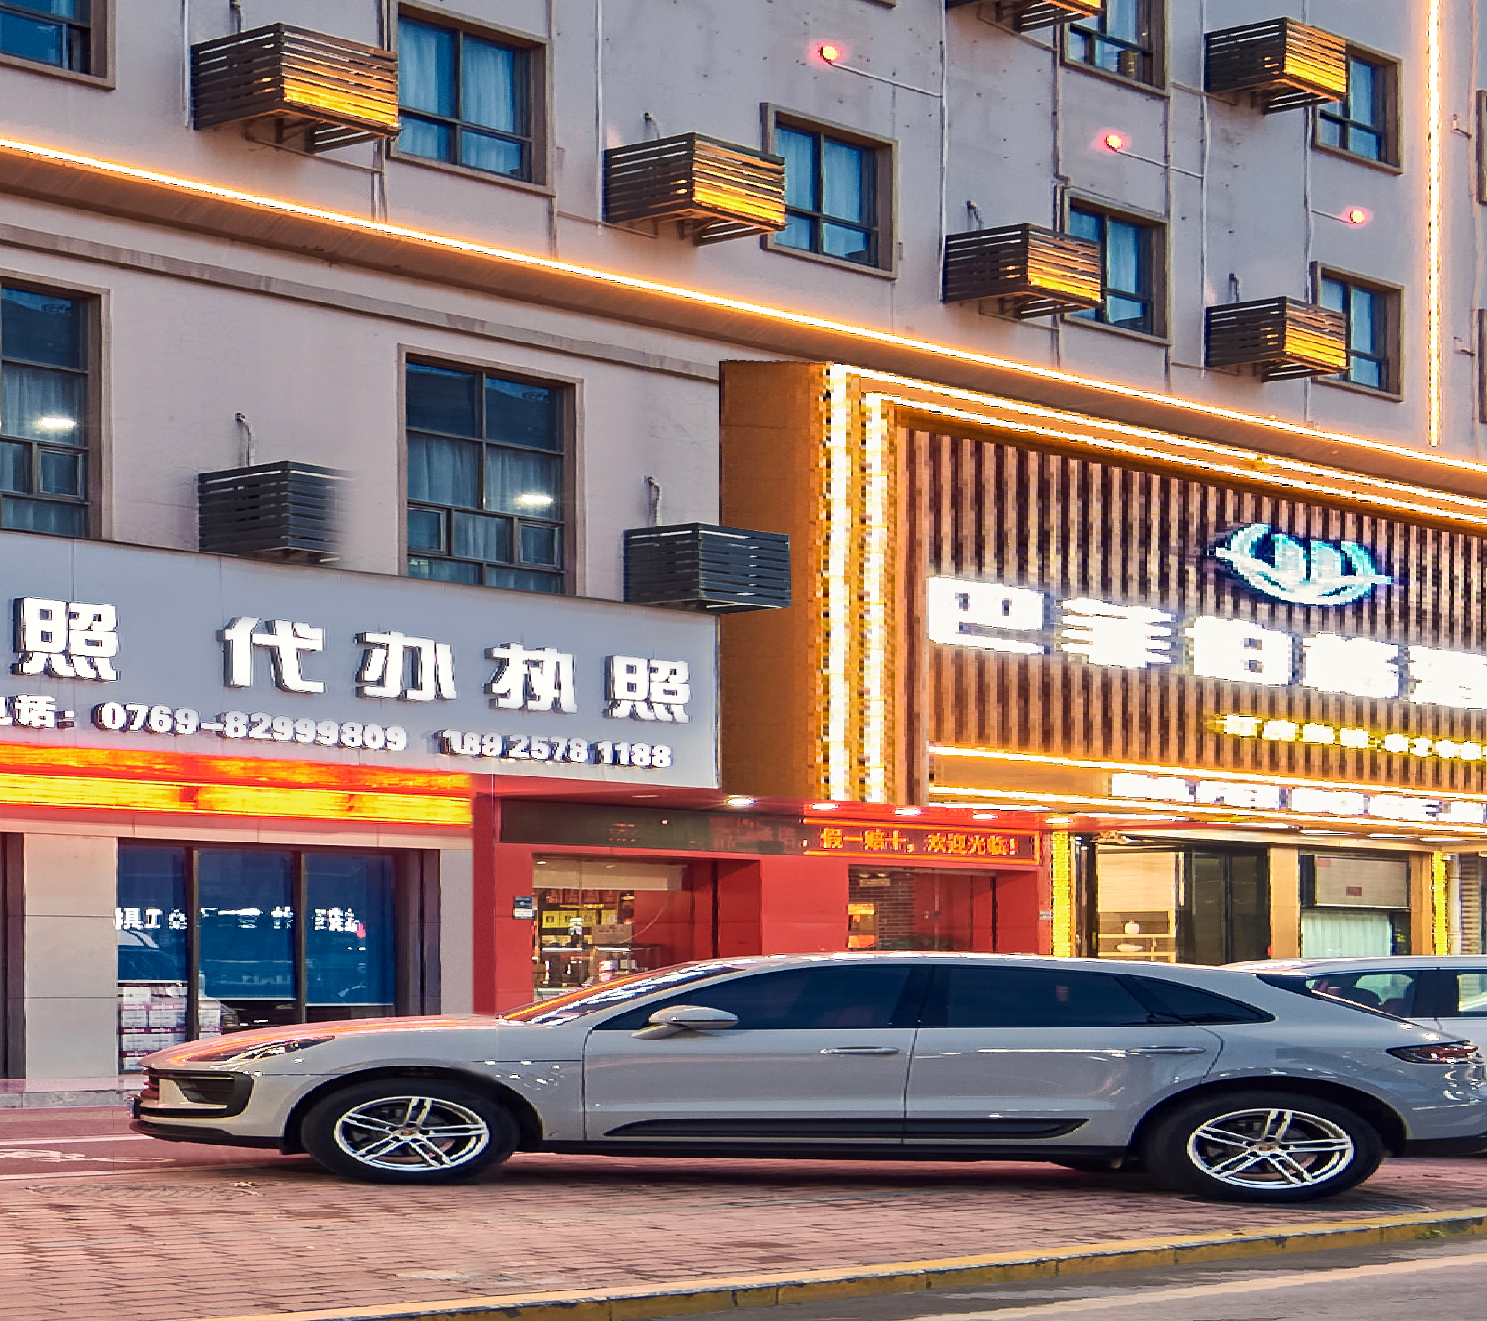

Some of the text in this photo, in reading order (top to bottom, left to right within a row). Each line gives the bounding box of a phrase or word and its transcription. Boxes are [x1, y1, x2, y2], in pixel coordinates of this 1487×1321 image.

[217, 616, 692, 724] 代办执照
[91, 701, 408, 751] 0769-82999809
